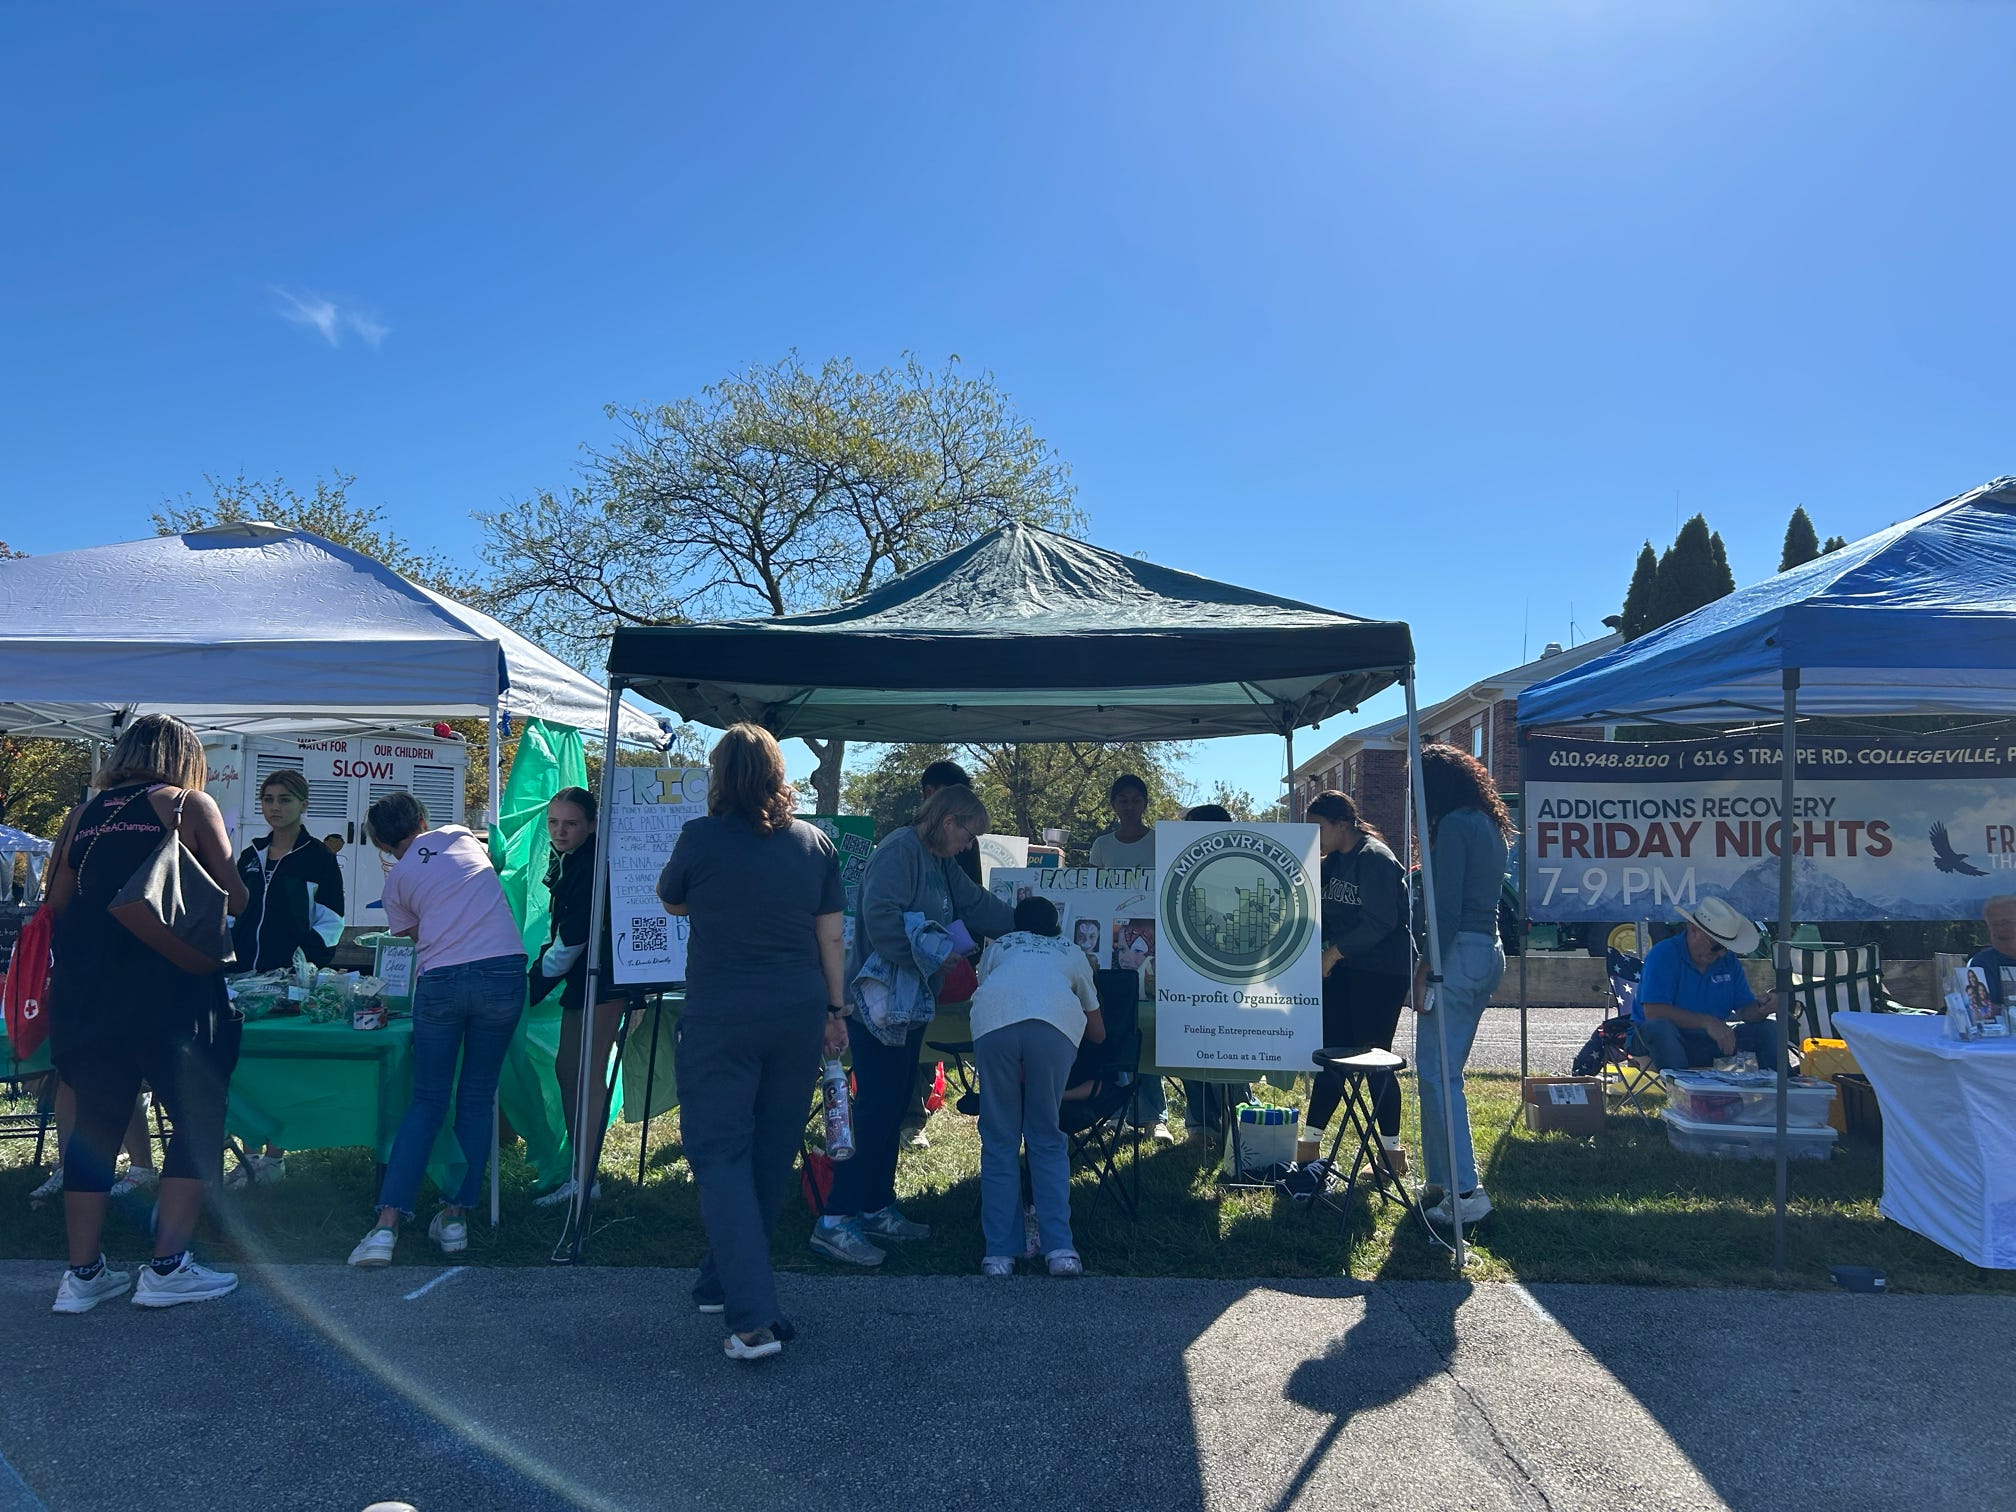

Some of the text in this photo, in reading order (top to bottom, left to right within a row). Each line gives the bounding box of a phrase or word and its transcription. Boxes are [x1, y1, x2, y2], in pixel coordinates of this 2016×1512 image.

[330, 741, 347, 753] FOR
[374, 744, 392, 757] OUR
[395, 746, 434, 760] CHILDREN
[1549, 750, 1670, 768] 610.948.8100
[1693, 750, 1728, 766] 616
[1733, 749, 1744, 765] S
[1749, 748, 1817, 764] TRAPE
[1821, 749, 1853, 764] RD.
[1857, 748, 2001, 765] COLLEGEVILLE,
[332, 759, 394, 780] SLOW!
[1537, 798, 1697, 819] ADDICTIONS
[1537, 820, 1893, 858] FRIDAY NIGHTS
[1174, 834, 1306, 887] MICRO VRA FUND
[1039, 868, 1089, 889] FACE
[1537, 866, 1697, 906] 7-9 PM
[1158, 988, 1320, 1008] Non-profit Organization
[1184, 1024, 1294, 1039] Fueling Entrepreneurship
[1196, 1050, 1214, 1060] One
[1216, 1050, 1238, 1061] Loan
[1240, 1053, 1249, 1061] at
[1258, 1052, 1282, 1062] Time
